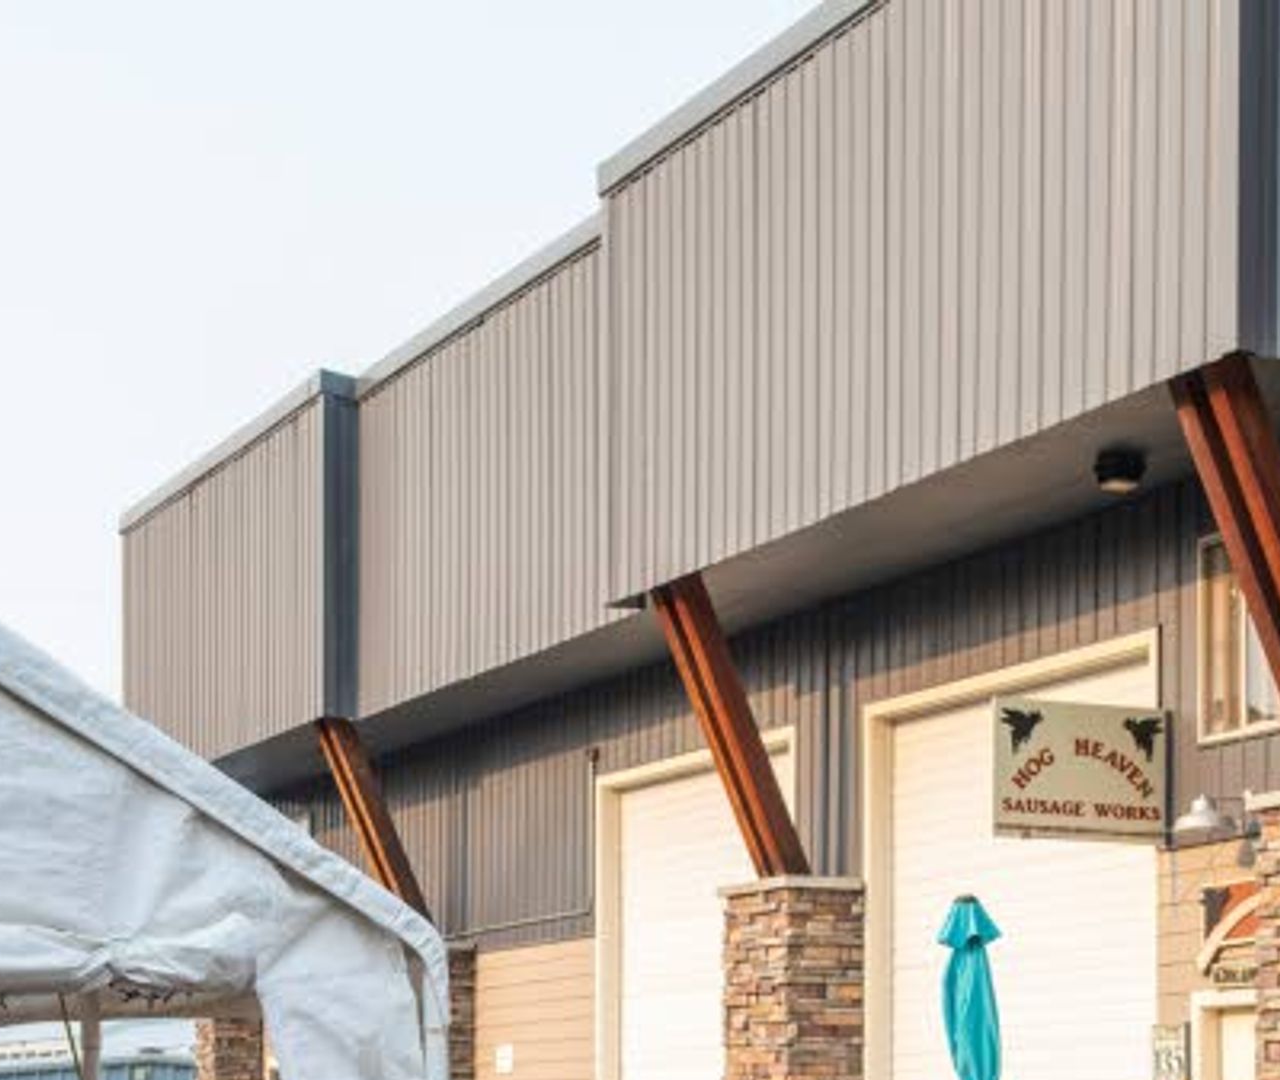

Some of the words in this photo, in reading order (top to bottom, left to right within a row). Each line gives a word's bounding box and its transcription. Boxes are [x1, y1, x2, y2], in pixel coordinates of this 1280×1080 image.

[1011, 747, 1055, 790] HOG
[1074, 738, 1154, 798] HEAVEN
[1002, 797, 1086, 817] SAUSAGE
[1094, 803, 1161, 821] WORKS
